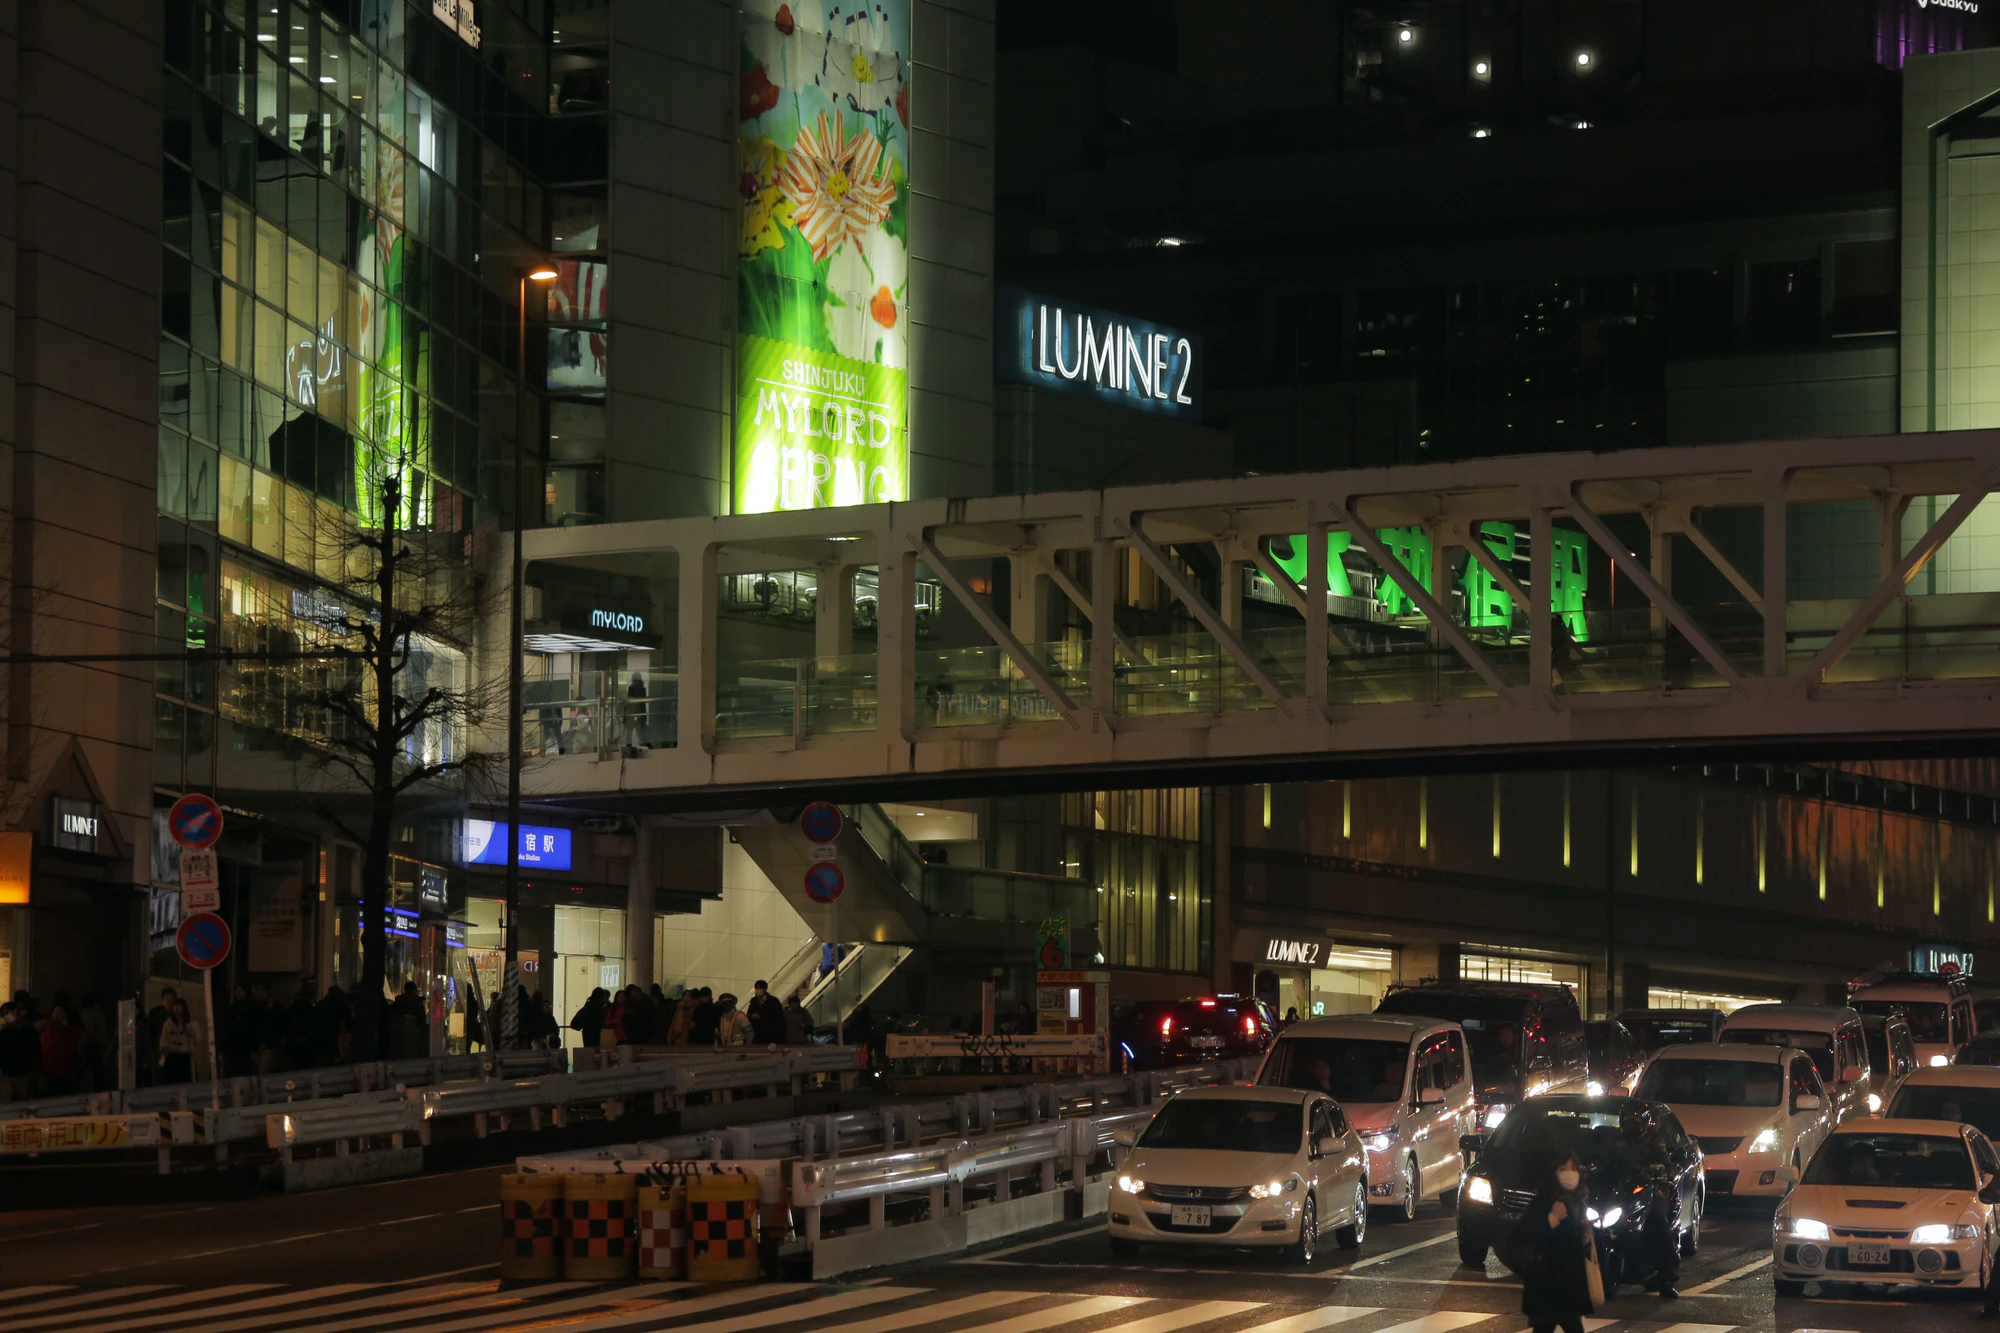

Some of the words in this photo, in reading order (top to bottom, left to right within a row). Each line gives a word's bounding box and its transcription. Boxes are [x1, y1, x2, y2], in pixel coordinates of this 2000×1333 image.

[1039, 303, 1168, 399] LUMINE
[1176, 338, 1192, 404] 2
[782, 359, 865, 396] SHINJUKU
[754, 387, 891, 449] MYLORD
[592, 609, 643, 632] MYLORD
[64, 814, 92, 836] LUMINE
[526, 833, 554, 853] 宿駅
[525, 853, 540, 862] Station
[1041, 937, 1064, 968] 6
[1266, 939, 1311, 963] LUMINE
[1308, 943, 1319, 963] 2
[1967, 953, 1974, 977] 2
[1311, 1001, 1325, 1015] JR
[1857, 1251, 1888, 1262] 60-24
